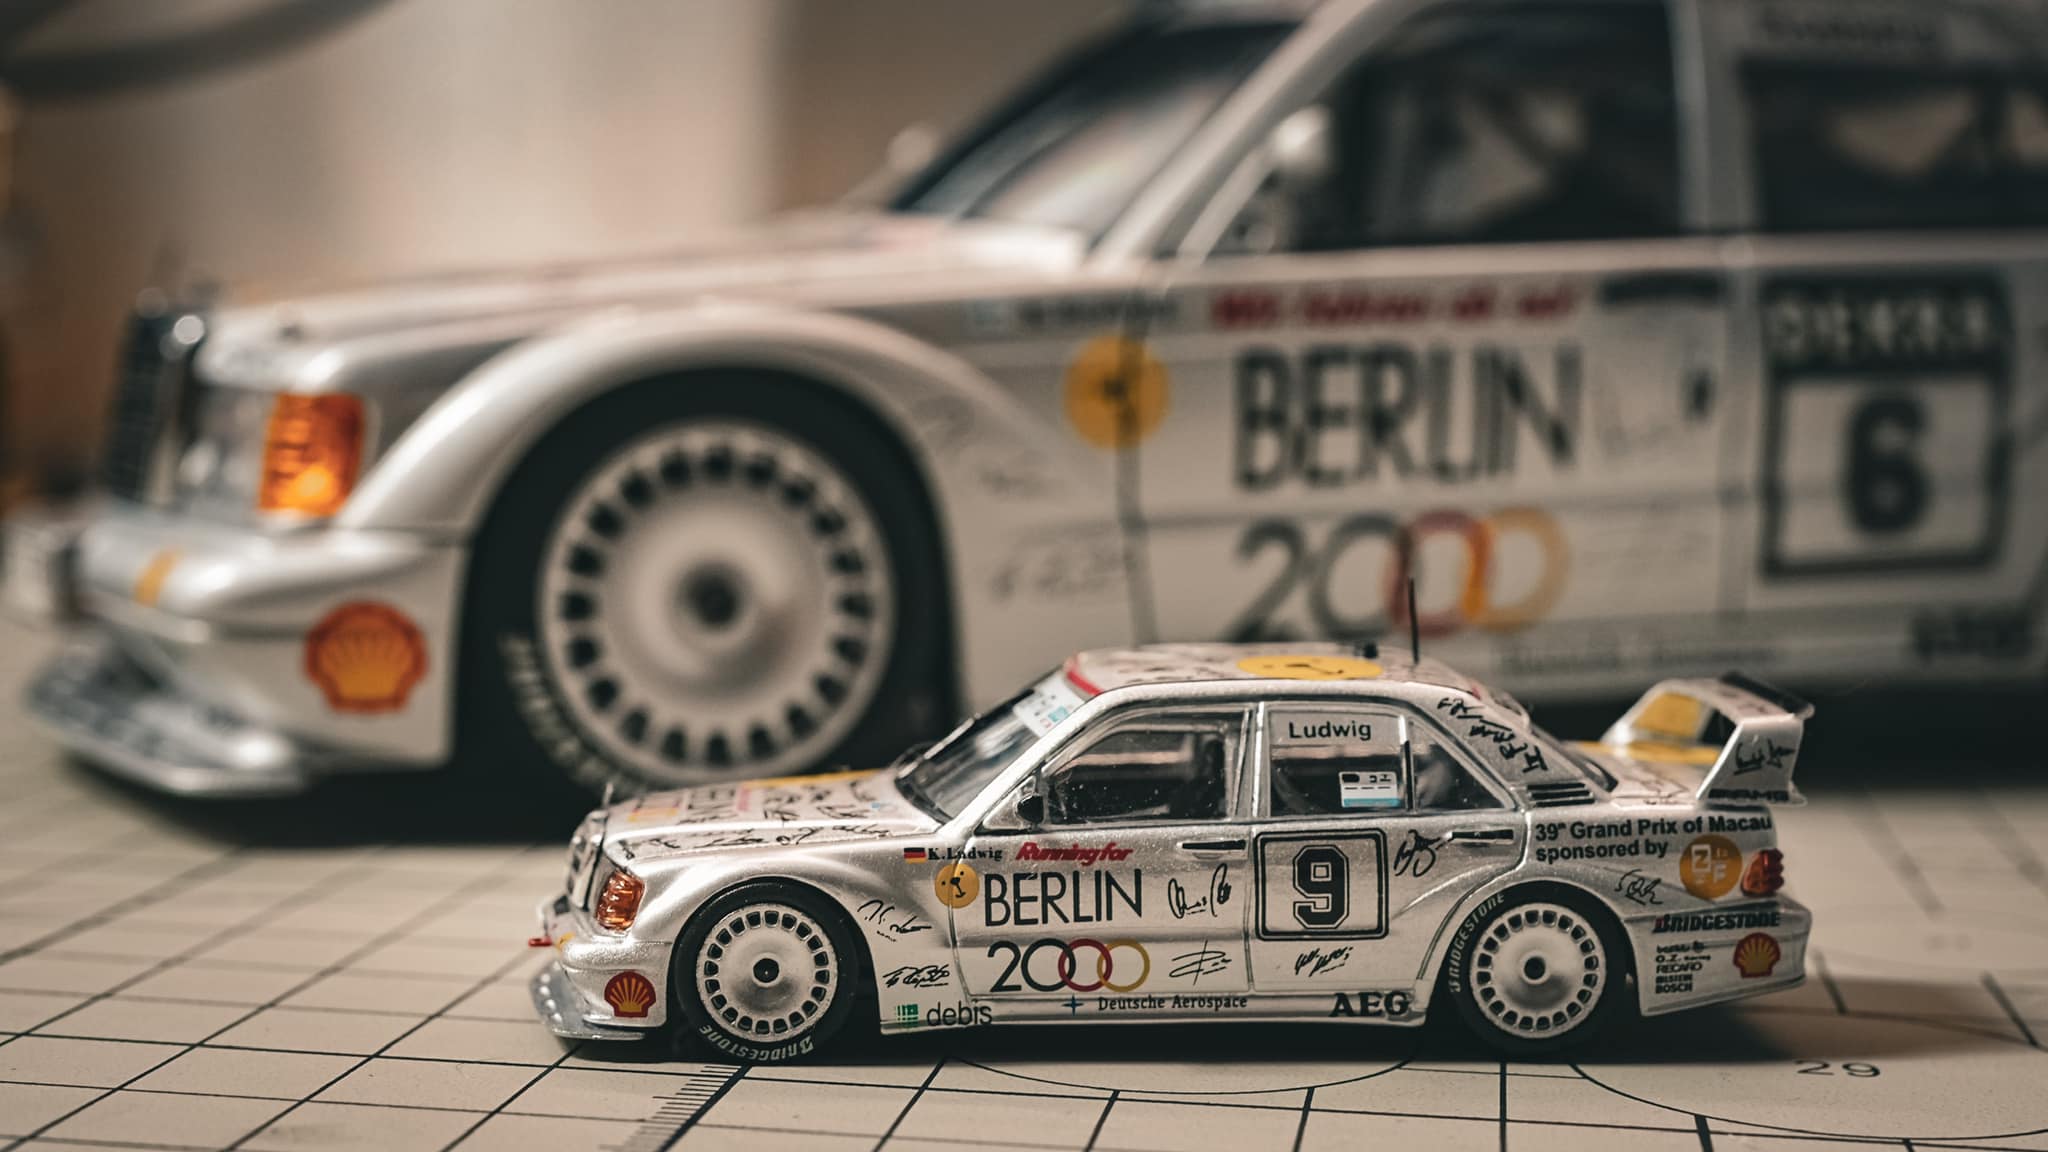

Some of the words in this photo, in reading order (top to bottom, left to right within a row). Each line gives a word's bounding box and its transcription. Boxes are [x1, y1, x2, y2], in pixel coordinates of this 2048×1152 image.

[1233, 342, 1584, 492] BERLIN
[1840, 391, 1935, 537] 6
[1224, 506, 1573, 645] 2000
[1289, 720, 1372, 741] Ludwig
[1570, 819, 1632, 839] Grand
[1638, 818, 1678, 835] Prix
[1683, 816, 1704, 833] of
[1708, 815, 1772, 833] Macau
[1016, 841, 1098, 866] Running
[1535, 841, 1640, 864] sponsored
[1645, 839, 1669, 858] by
[984, 868, 1143, 927] BERLIN
[1292, 845, 1350, 930] 9
[987, 937, 1151, 993] 2000
[926, 1001, 993, 1027] debis
[1098, 994, 1166, 1011] Deutsche
[1171, 994, 1248, 1011] Aerospace
[1328, 991, 1411, 1018] AEG
[1794, 1059, 1881, 1078] 29
